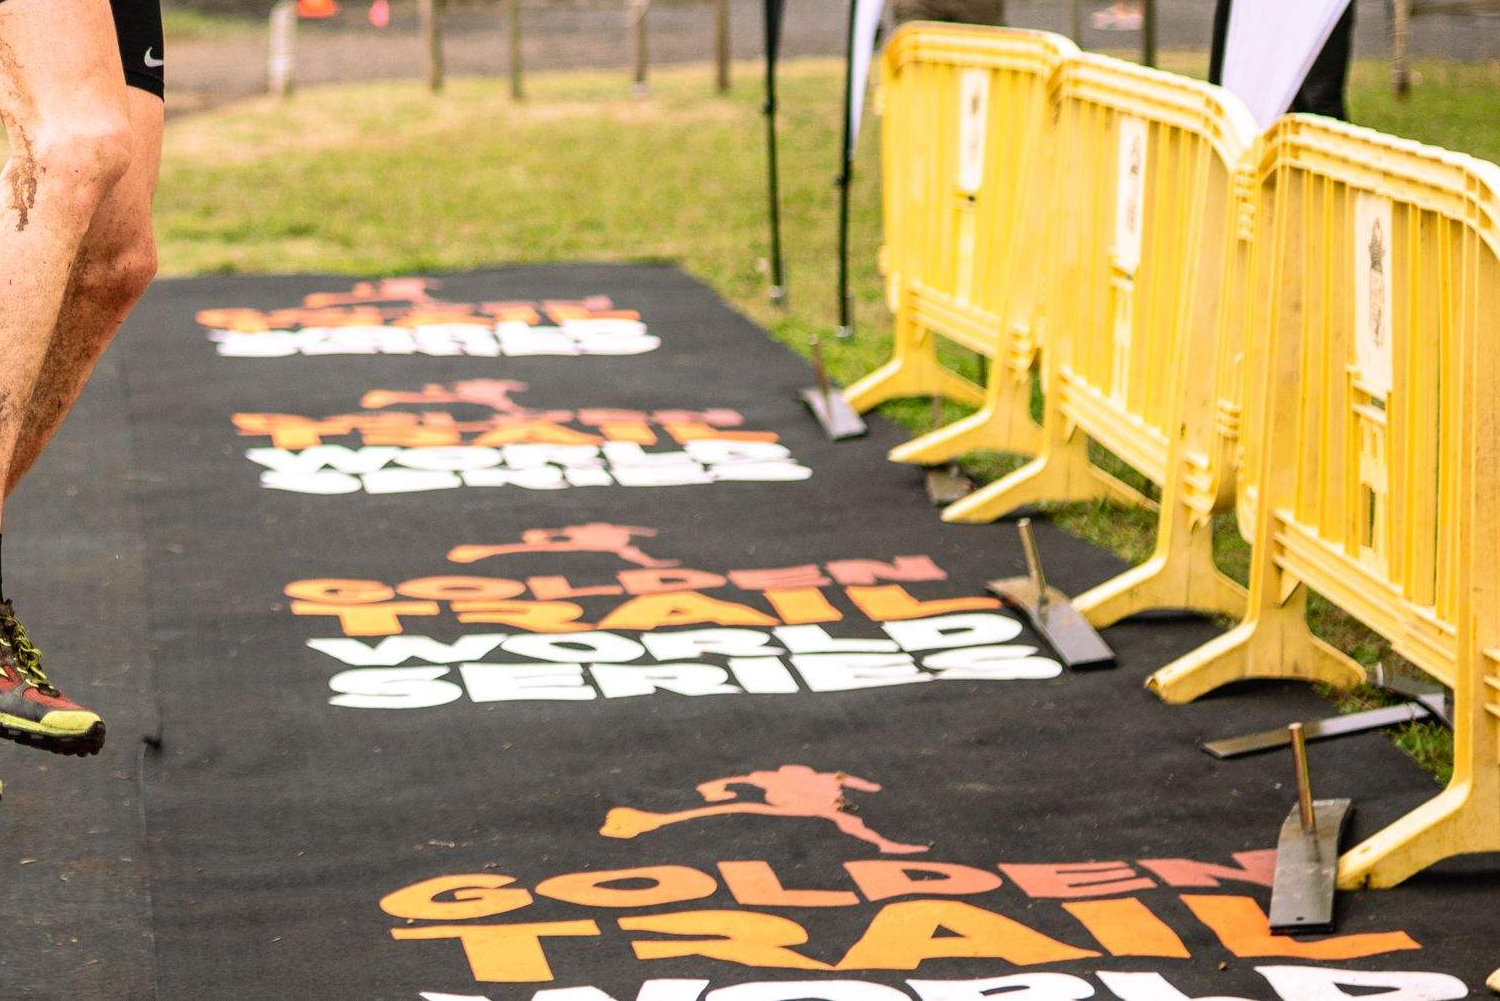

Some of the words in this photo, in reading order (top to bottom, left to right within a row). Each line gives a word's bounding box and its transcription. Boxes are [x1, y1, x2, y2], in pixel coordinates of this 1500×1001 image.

[284, 555, 947, 604] GOLDEN
[291, 585, 1001, 637] TRAIL
[306, 612, 1024, 666] WORLD
[328, 645, 1063, 709] SERIES
[390, 893, 1423, 983] TRAIL
